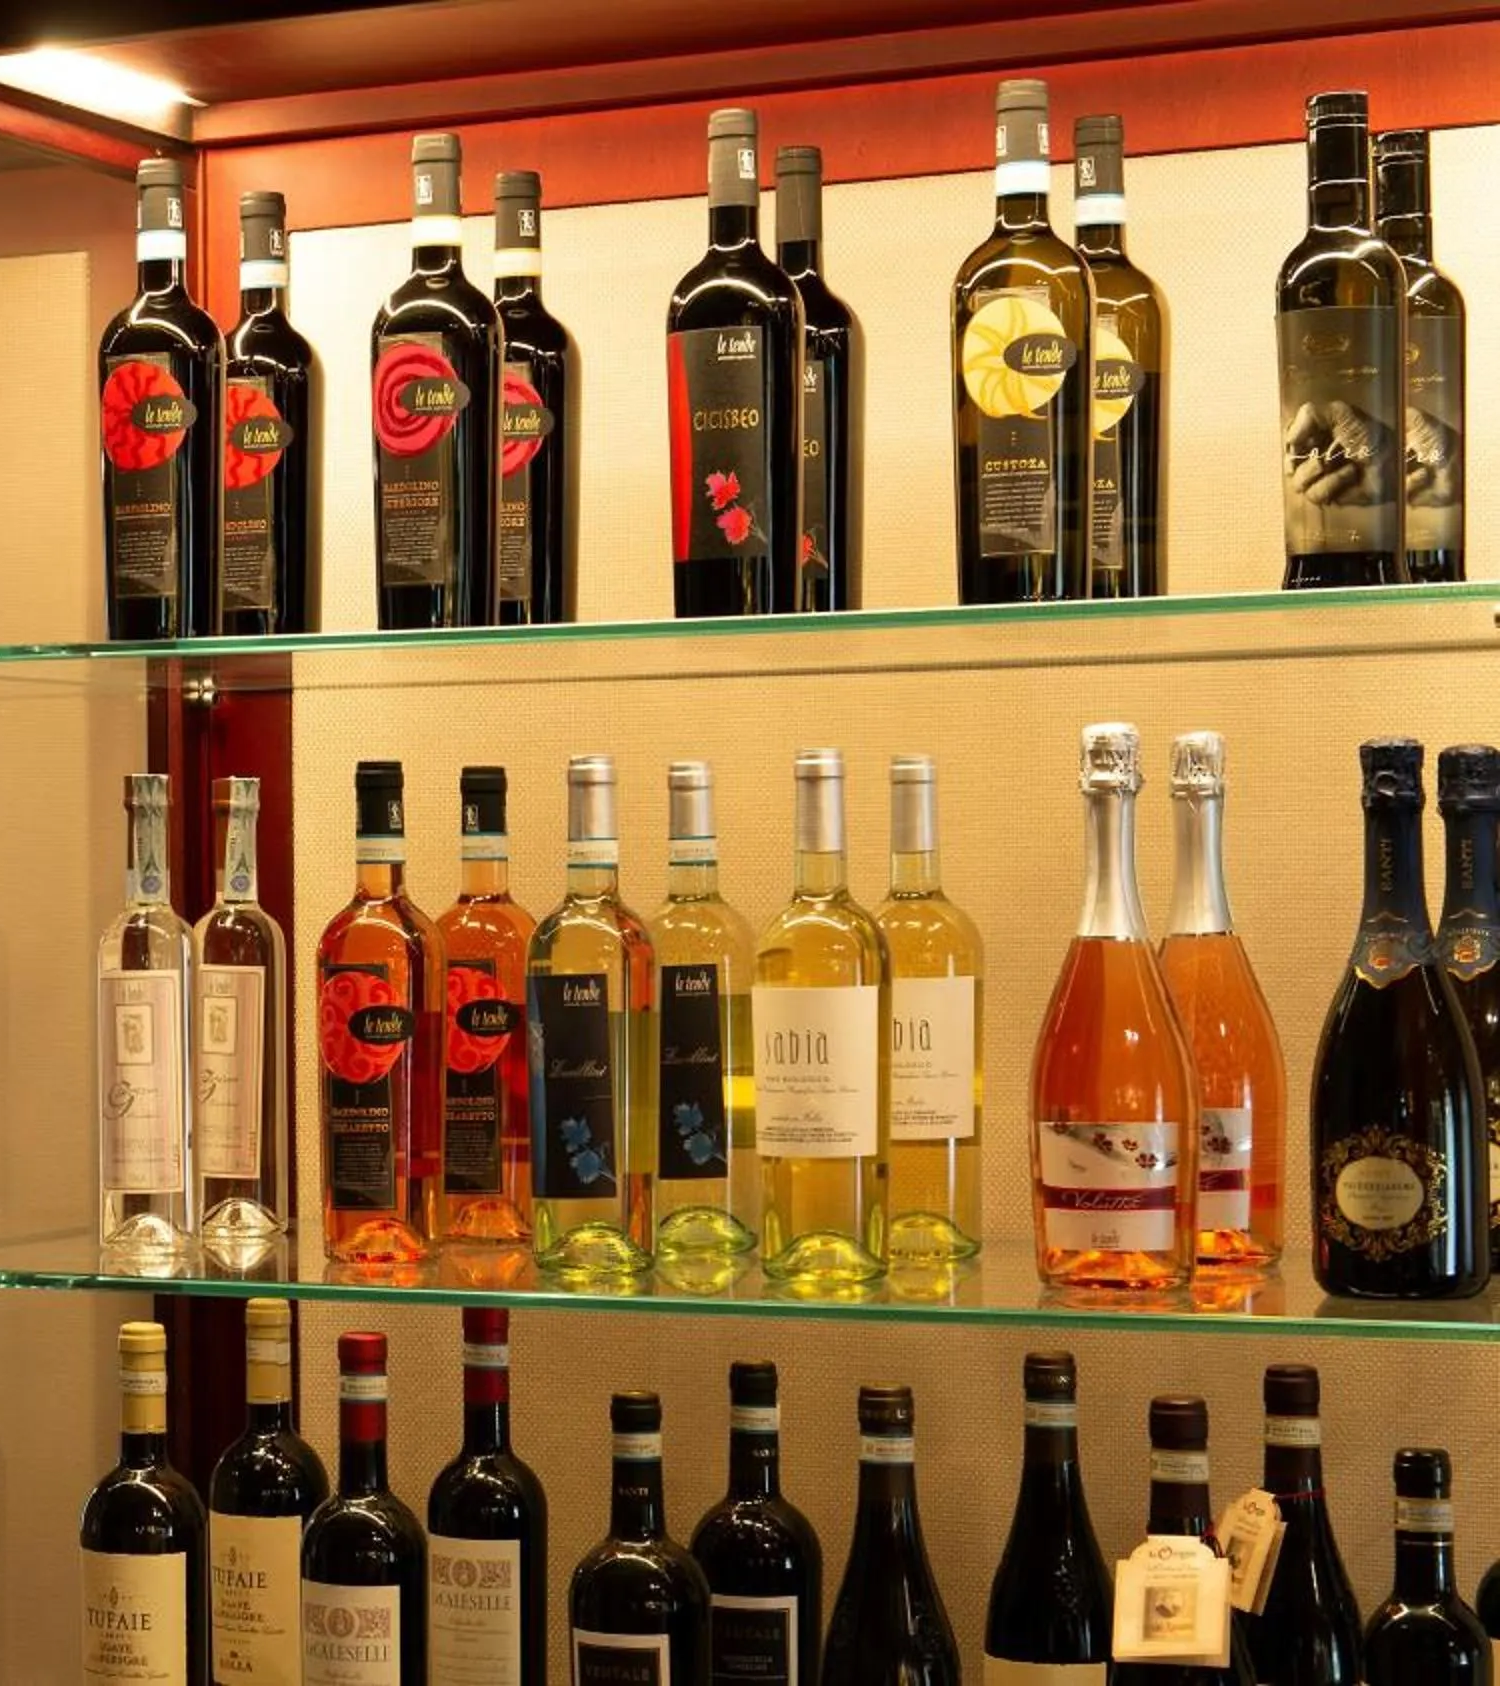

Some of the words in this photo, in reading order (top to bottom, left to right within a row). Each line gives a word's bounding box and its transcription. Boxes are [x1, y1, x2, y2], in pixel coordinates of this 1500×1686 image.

[1022, 344, 1032, 364] le
[1036, 341, 1063, 363] tende
[693, 409, 759, 430] CICISBEO
[985, 458, 1047, 472] CUSTOZA
[563, 981, 573, 1001] le
[575, 979, 600, 1001] tende
[893, 1017, 932, 1052] bia
[765, 1028, 830, 1066] sabia
[88, 1607, 152, 1631] TUFAIE
